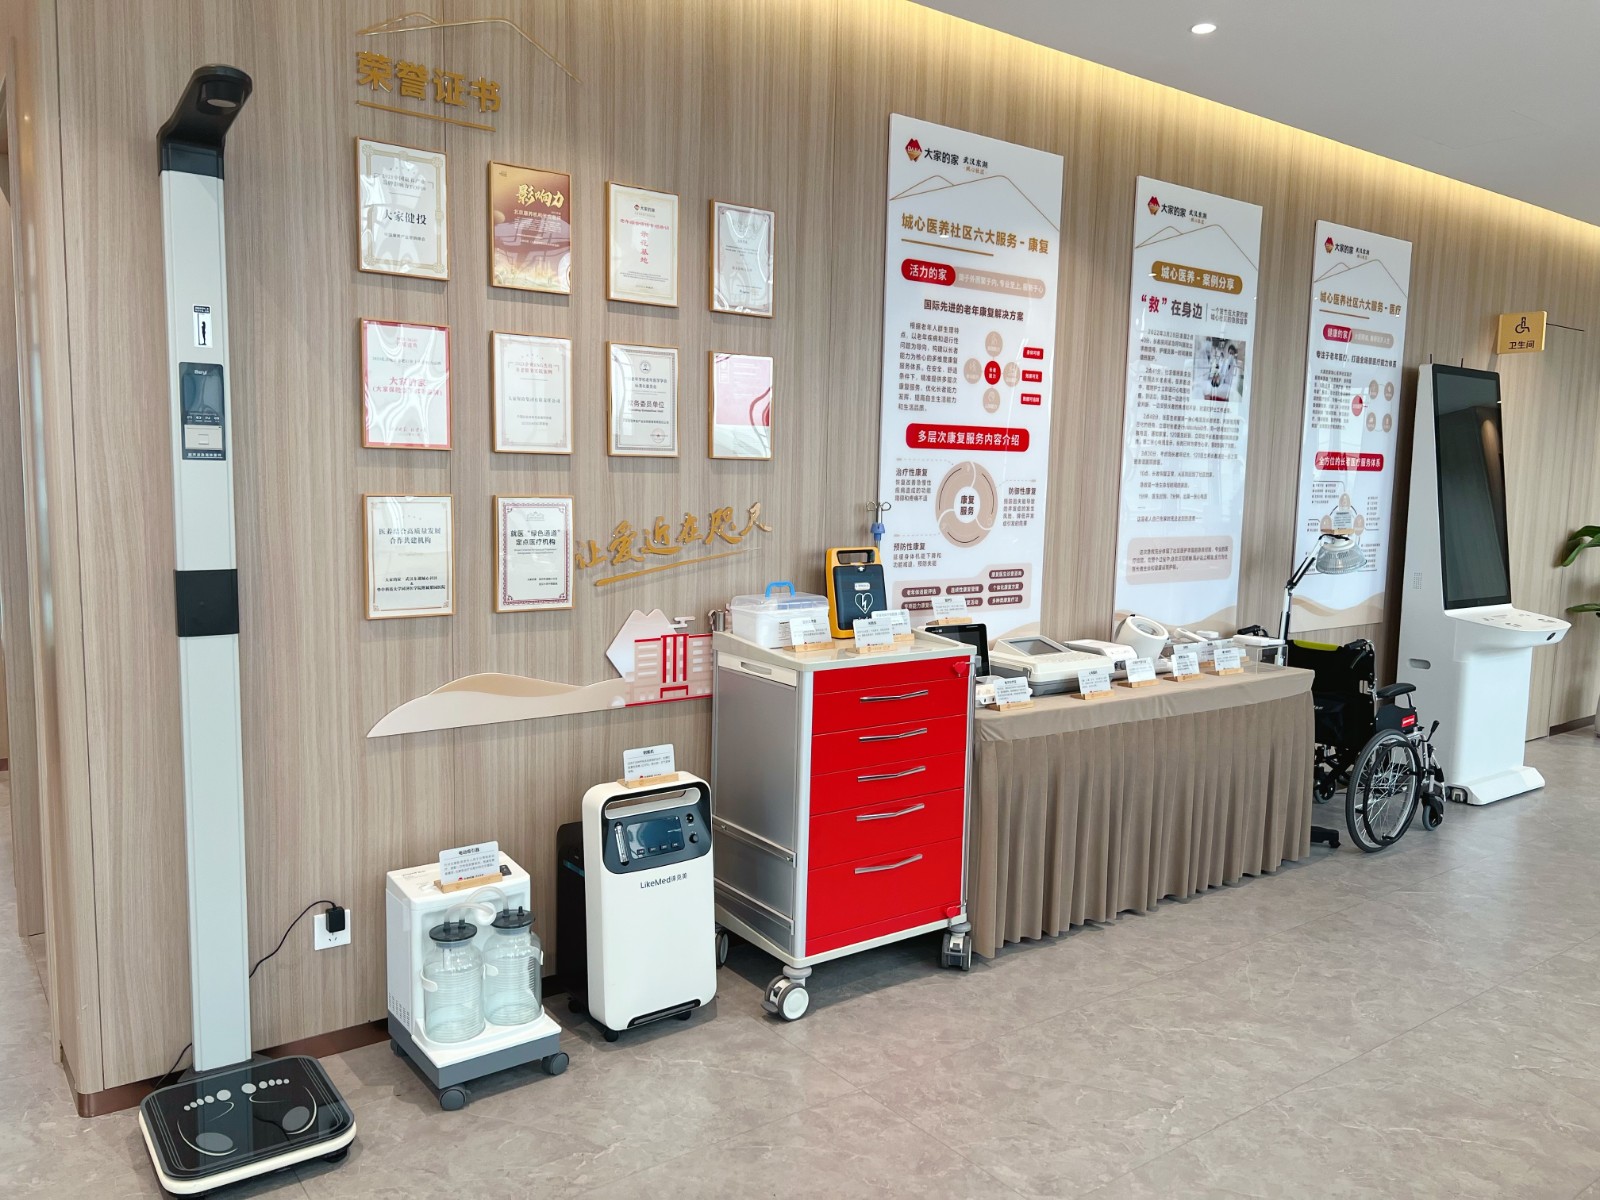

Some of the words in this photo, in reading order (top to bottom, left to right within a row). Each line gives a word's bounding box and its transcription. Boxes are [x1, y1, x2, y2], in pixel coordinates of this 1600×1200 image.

[357, 51, 502, 113] 荣誉证书
[924, 148, 959, 166] 大家的家
[962, 156, 988, 169] 武汉东湖
[516, 184, 564, 208] 影响力
[384, 209, 427, 225] 大家健投
[1161, 203, 1187, 218] 大家的家
[909, 263, 947, 281] 活力的家
[923, 299, 1024, 322] 国际先进的老年康复解决方案
[1508, 340, 1535, 350] 卫生间
[917, 430, 1020, 447] 多层次康复服务内容介绍
[895, 468, 928, 477] 治疗性康复
[960, 495, 975, 505] 康复
[960, 506, 974, 516] 服务
[379, 527, 441, 535] 医养结合高质量发展
[576, 502, 772, 570] 让爱近在咫尺
[390, 537, 432, 545] 合作共建机构
[515, 538, 556, 546] 定点医疗机构
[893, 542, 926, 551] 预防性康复
[640, 876, 671, 889] LikeMed
